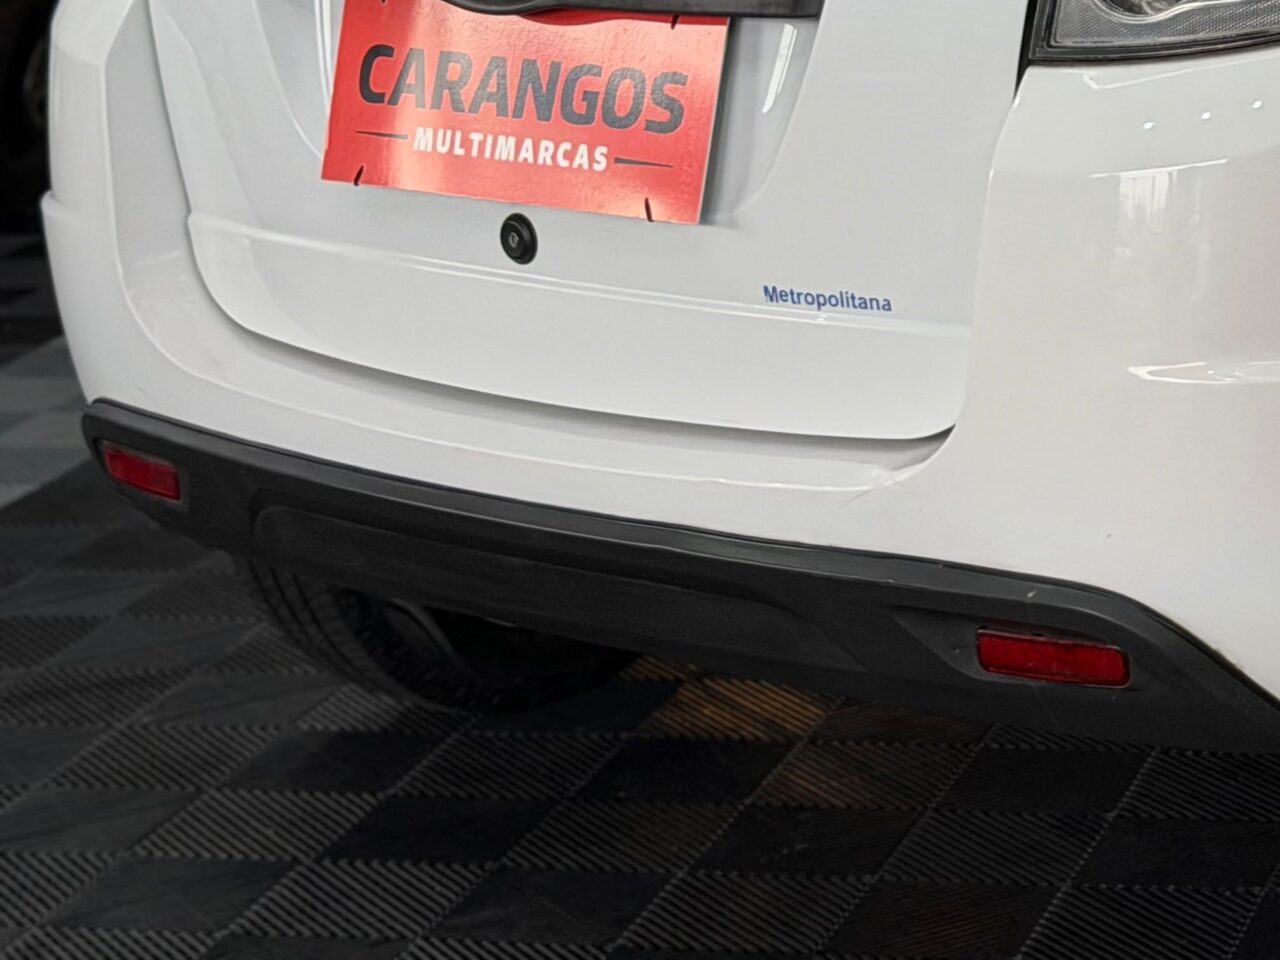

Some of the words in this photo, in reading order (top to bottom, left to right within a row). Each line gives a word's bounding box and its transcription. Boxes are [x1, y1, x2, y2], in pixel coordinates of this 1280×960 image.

[358, 43, 689, 135] CARANGOS
[413, 126, 609, 172] MULTIMARCAS
[763, 285, 892, 312] Metropolitana
